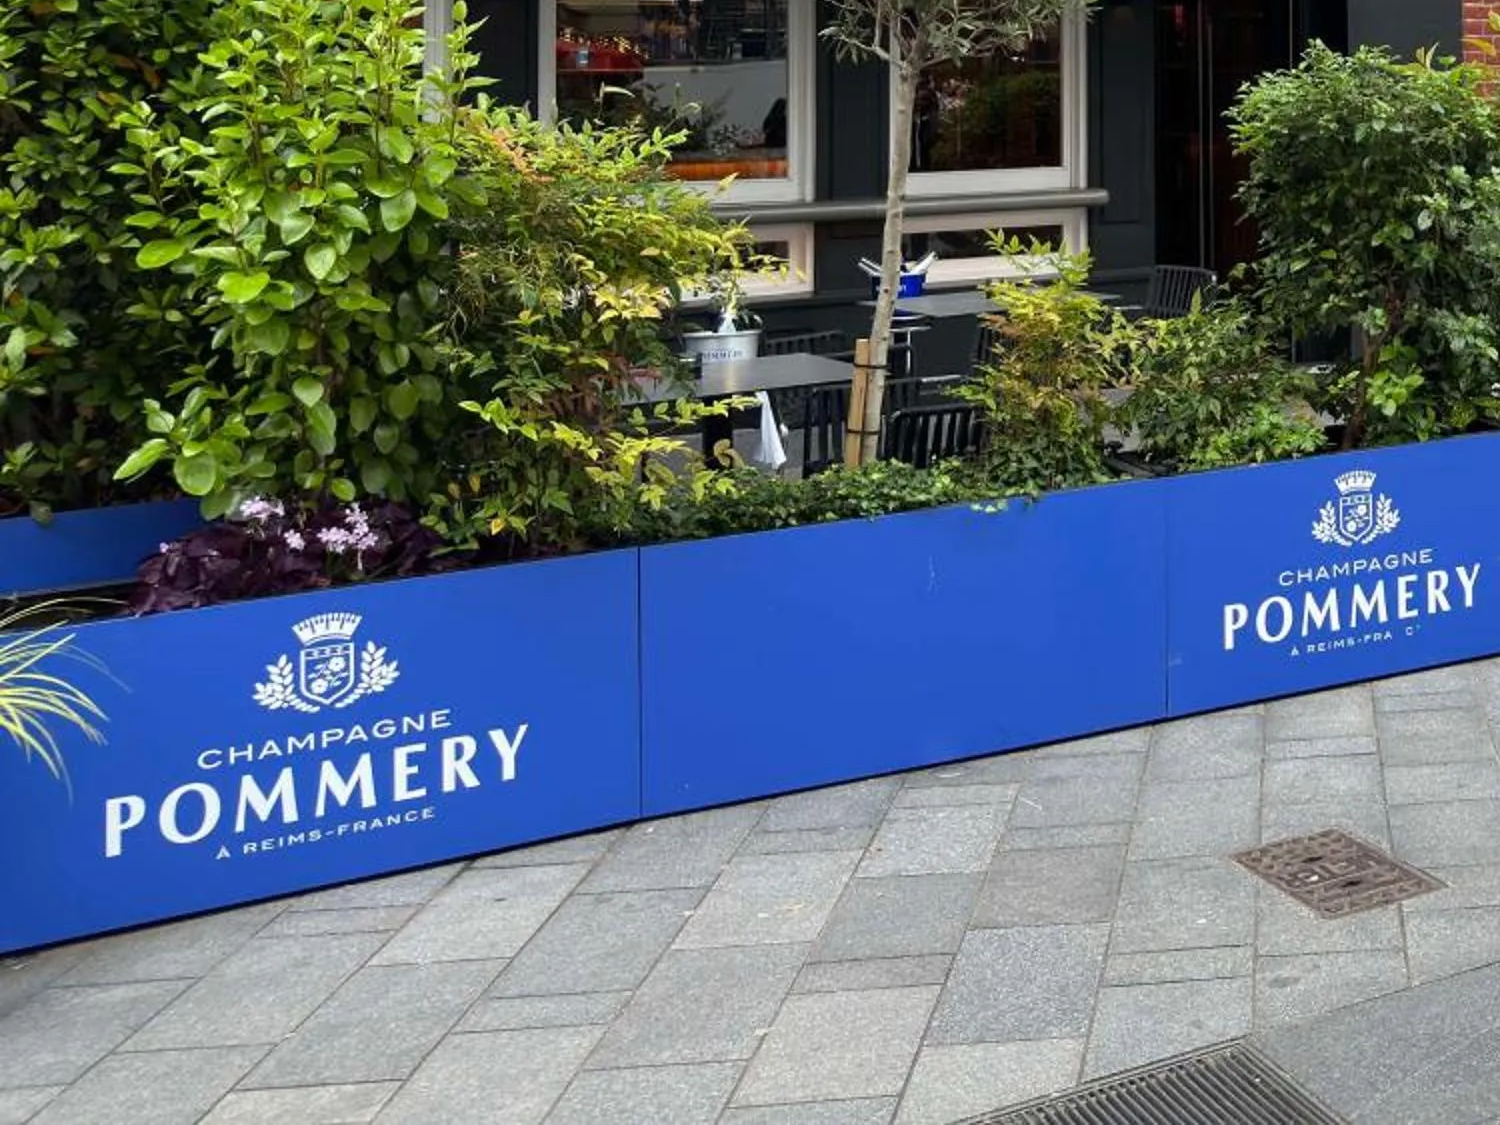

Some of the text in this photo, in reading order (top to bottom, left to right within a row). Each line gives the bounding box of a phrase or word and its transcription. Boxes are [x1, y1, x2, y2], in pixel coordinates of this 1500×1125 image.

[1278, 548, 1434, 587] CHAMPAGNE
[1223, 562, 1481, 651] POMMERY
[196, 708, 453, 771] CHAMPAGNE
[104, 724, 529, 858] POMMERY
[242, 806, 437, 856] REIMS-FRANCE
